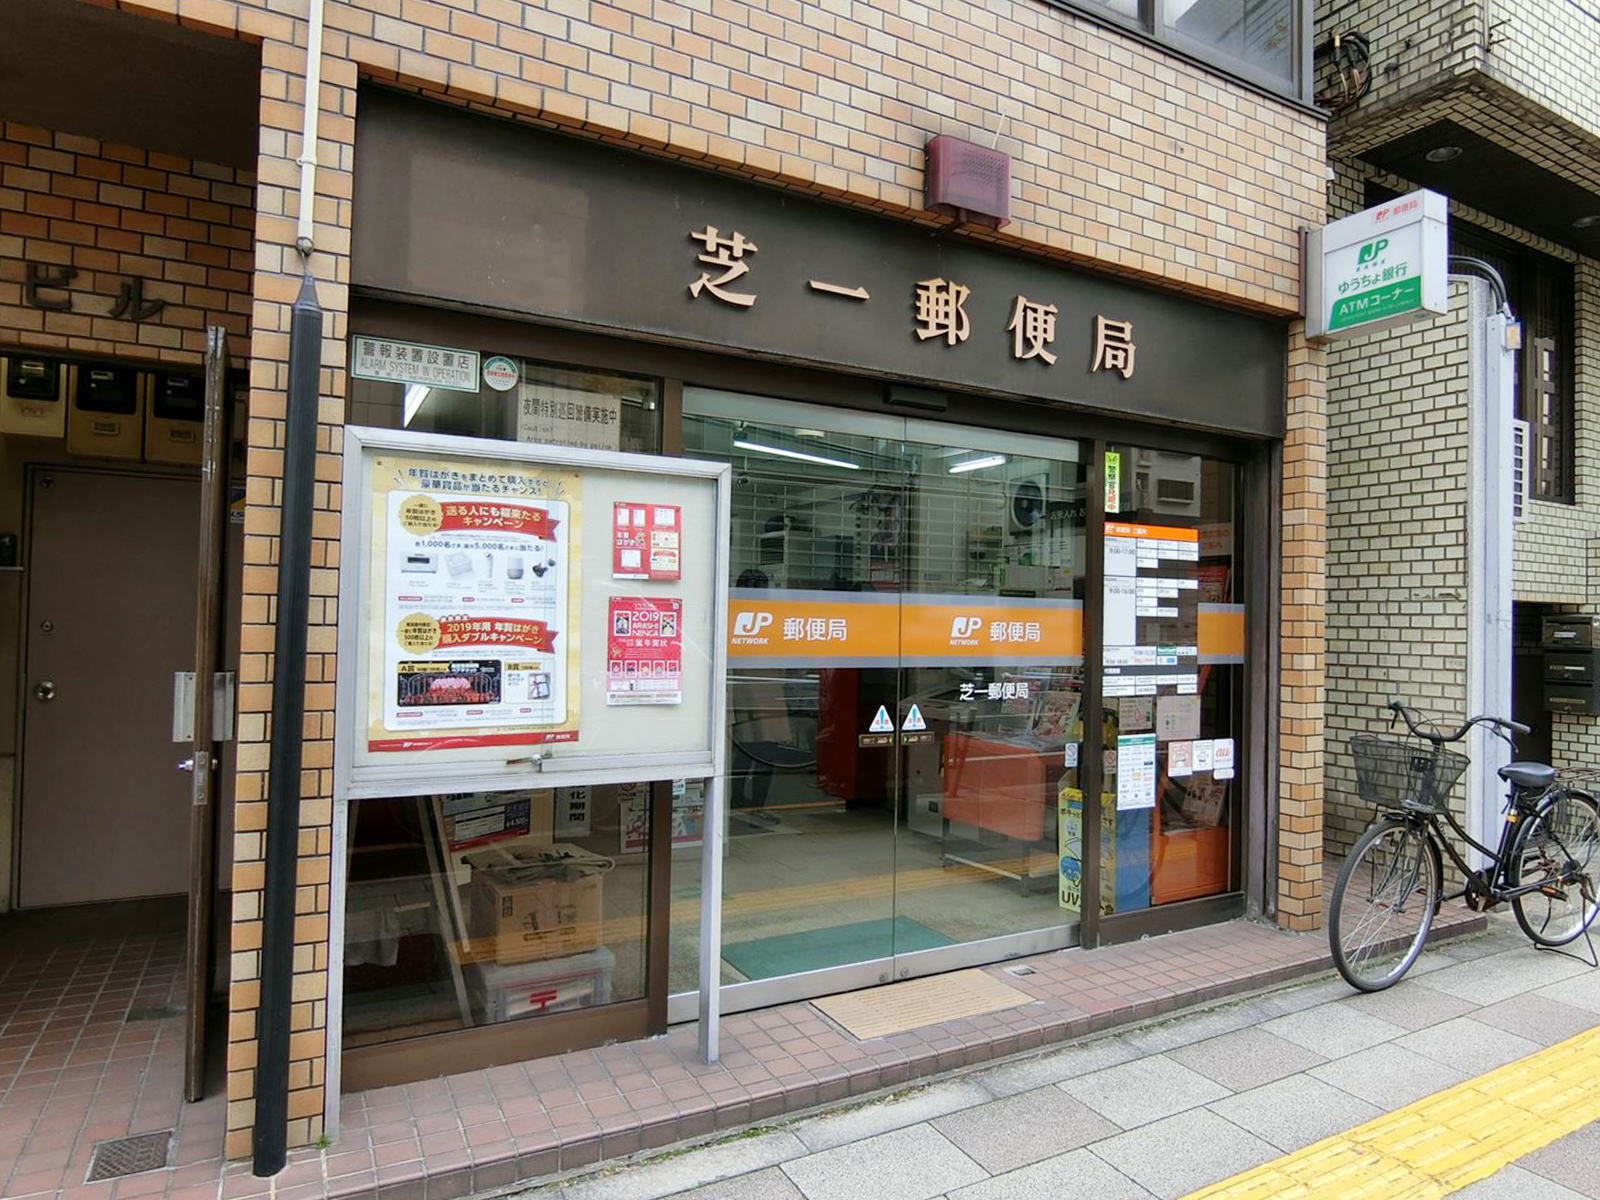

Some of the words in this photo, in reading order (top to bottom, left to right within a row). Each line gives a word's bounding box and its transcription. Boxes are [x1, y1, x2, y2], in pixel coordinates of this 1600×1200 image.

[1358, 238, 1389, 265] JP
[1338, 261, 1408, 295] ゆうちょ銀行
[1339, 287, 1414, 316] ATMコーナー
[362, 340, 470, 370] 警報装置設置店
[360, 357, 387, 371] ALARM
[389, 360, 419, 375] SYSTEM
[422, 365, 431, 377] IN
[432, 367, 471, 383] OPERATION
[523, 397, 617, 425] 夜間特別巡回警備実施中
[463, 517, 524, 529] キャンペーン
[632, 611, 660, 622] 2019
[734, 611, 774, 637] JP
[783, 616, 848, 642] 郵便局
[447, 622, 491, 633] 2019年用
[495, 623, 540, 635] 年賀はがき
[951, 616, 982, 639] JP
[989, 621, 1042, 643] 郵便局
[442, 633, 543, 645] 購入ダブルキャンペーン
[731, 636, 770, 646] NETWORK
[949, 637, 980, 647] NETWORK
[959, 681, 1030, 701] 芝一郵便局
[1215, 748, 1231, 758] au
[1061, 889, 1082, 907] UV
